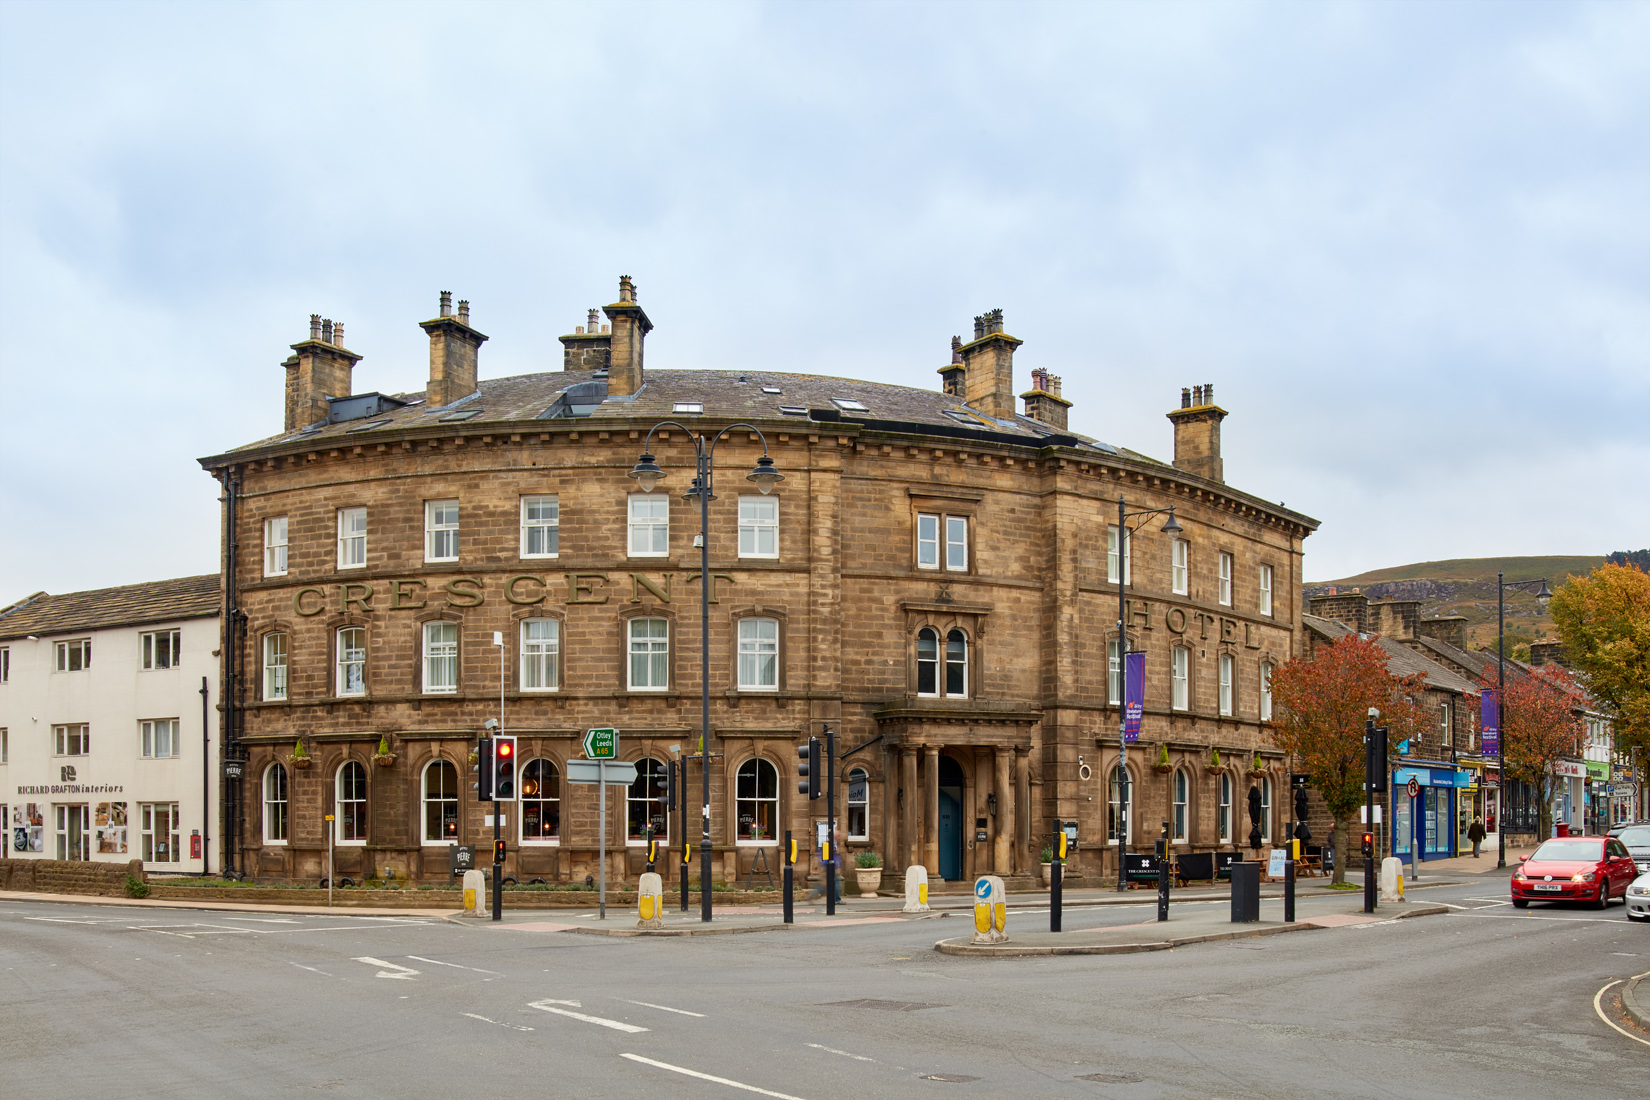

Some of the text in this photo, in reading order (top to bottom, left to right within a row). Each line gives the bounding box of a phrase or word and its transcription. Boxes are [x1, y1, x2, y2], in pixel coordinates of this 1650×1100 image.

[292, 572, 736, 617] CRESCENT
[1126, 599, 1261, 650] HOTEL
[596, 747, 609, 755] A65
[226, 767, 242, 775] PIERRE
[17, 783, 124, 795] RICHARD GRAFTON interiors
[456, 852, 471, 862] PIERRE
